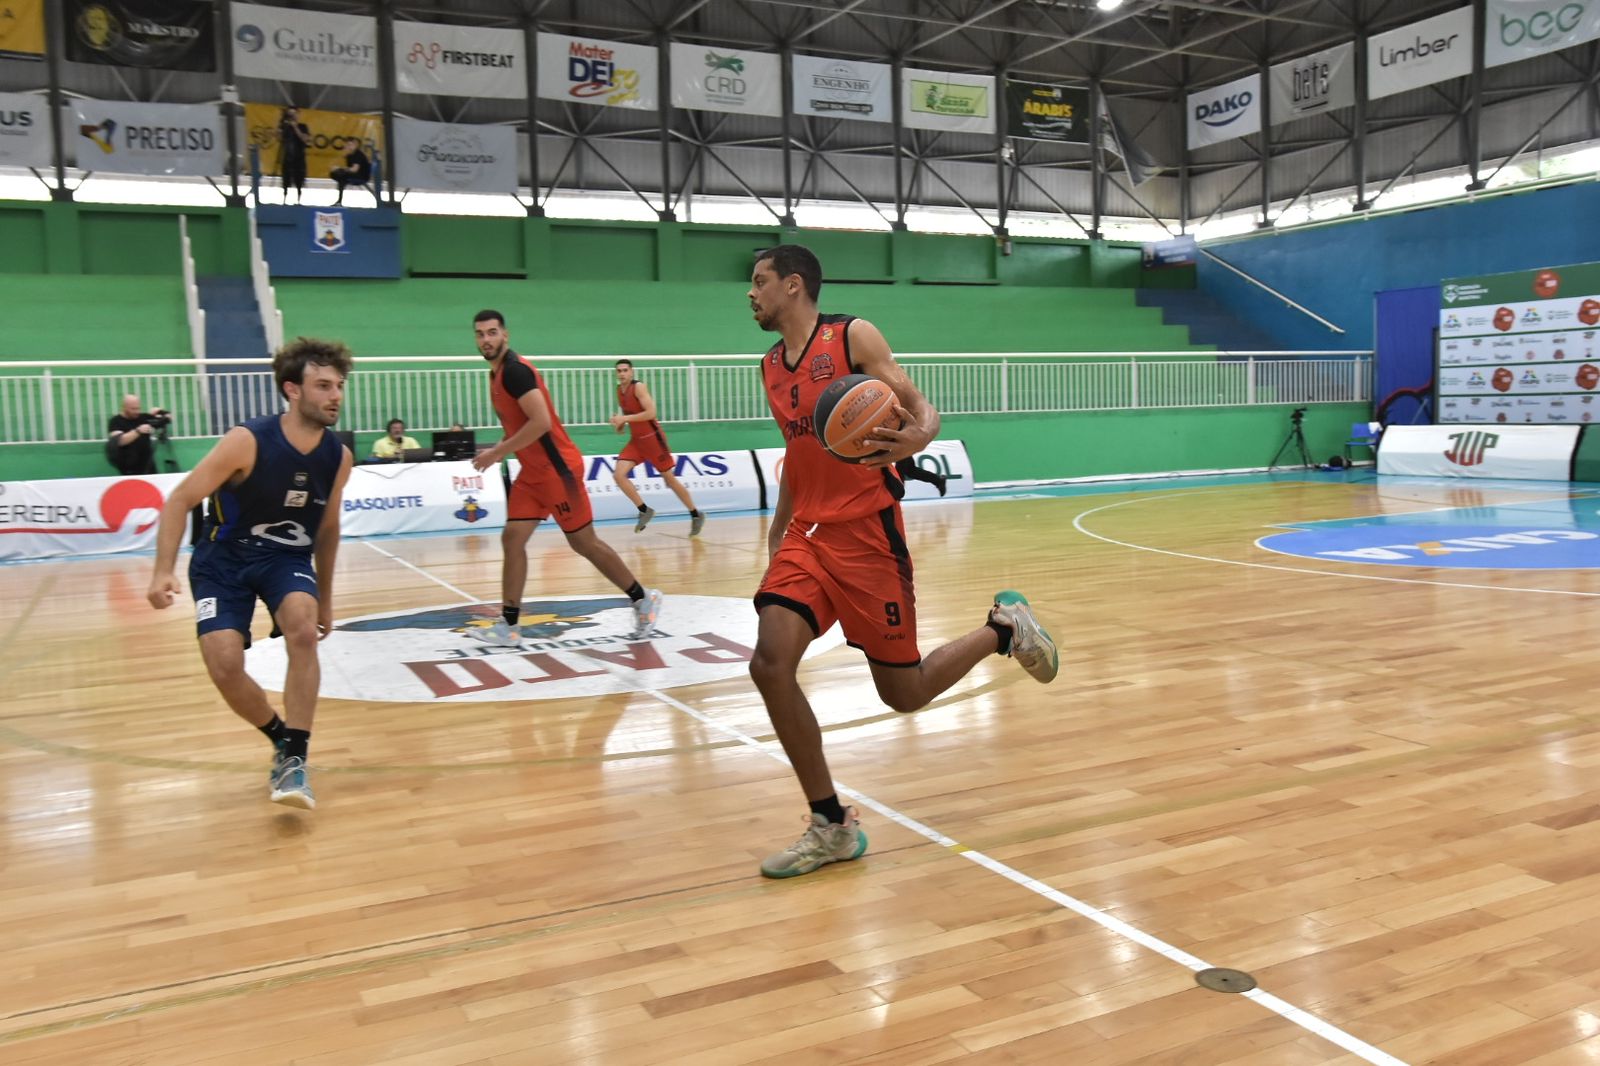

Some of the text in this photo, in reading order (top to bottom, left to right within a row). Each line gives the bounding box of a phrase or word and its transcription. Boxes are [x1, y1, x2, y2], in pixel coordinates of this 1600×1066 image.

[1499, 3, 1585, 47] bee
[273, 28, 376, 59] Guiber
[568, 41, 614, 60] Mater
[442, 50, 515, 68] FIRSTBEAT
[704, 75, 747, 96] CRD
[813, 77, 870, 91] ENGENHO
[1195, 91, 1253, 120] DAKO
[125, 126, 214, 151] PRECISO
[790, 384, 799, 410] 9
[1443, 431, 1500, 466] JUP
[452, 475, 484, 491] PATO
[343, 494, 424, 513] BASQUETE
[554, 500, 571, 517] 14
[884, 602, 901, 627] 9
[398, 631, 757, 699] PATO
